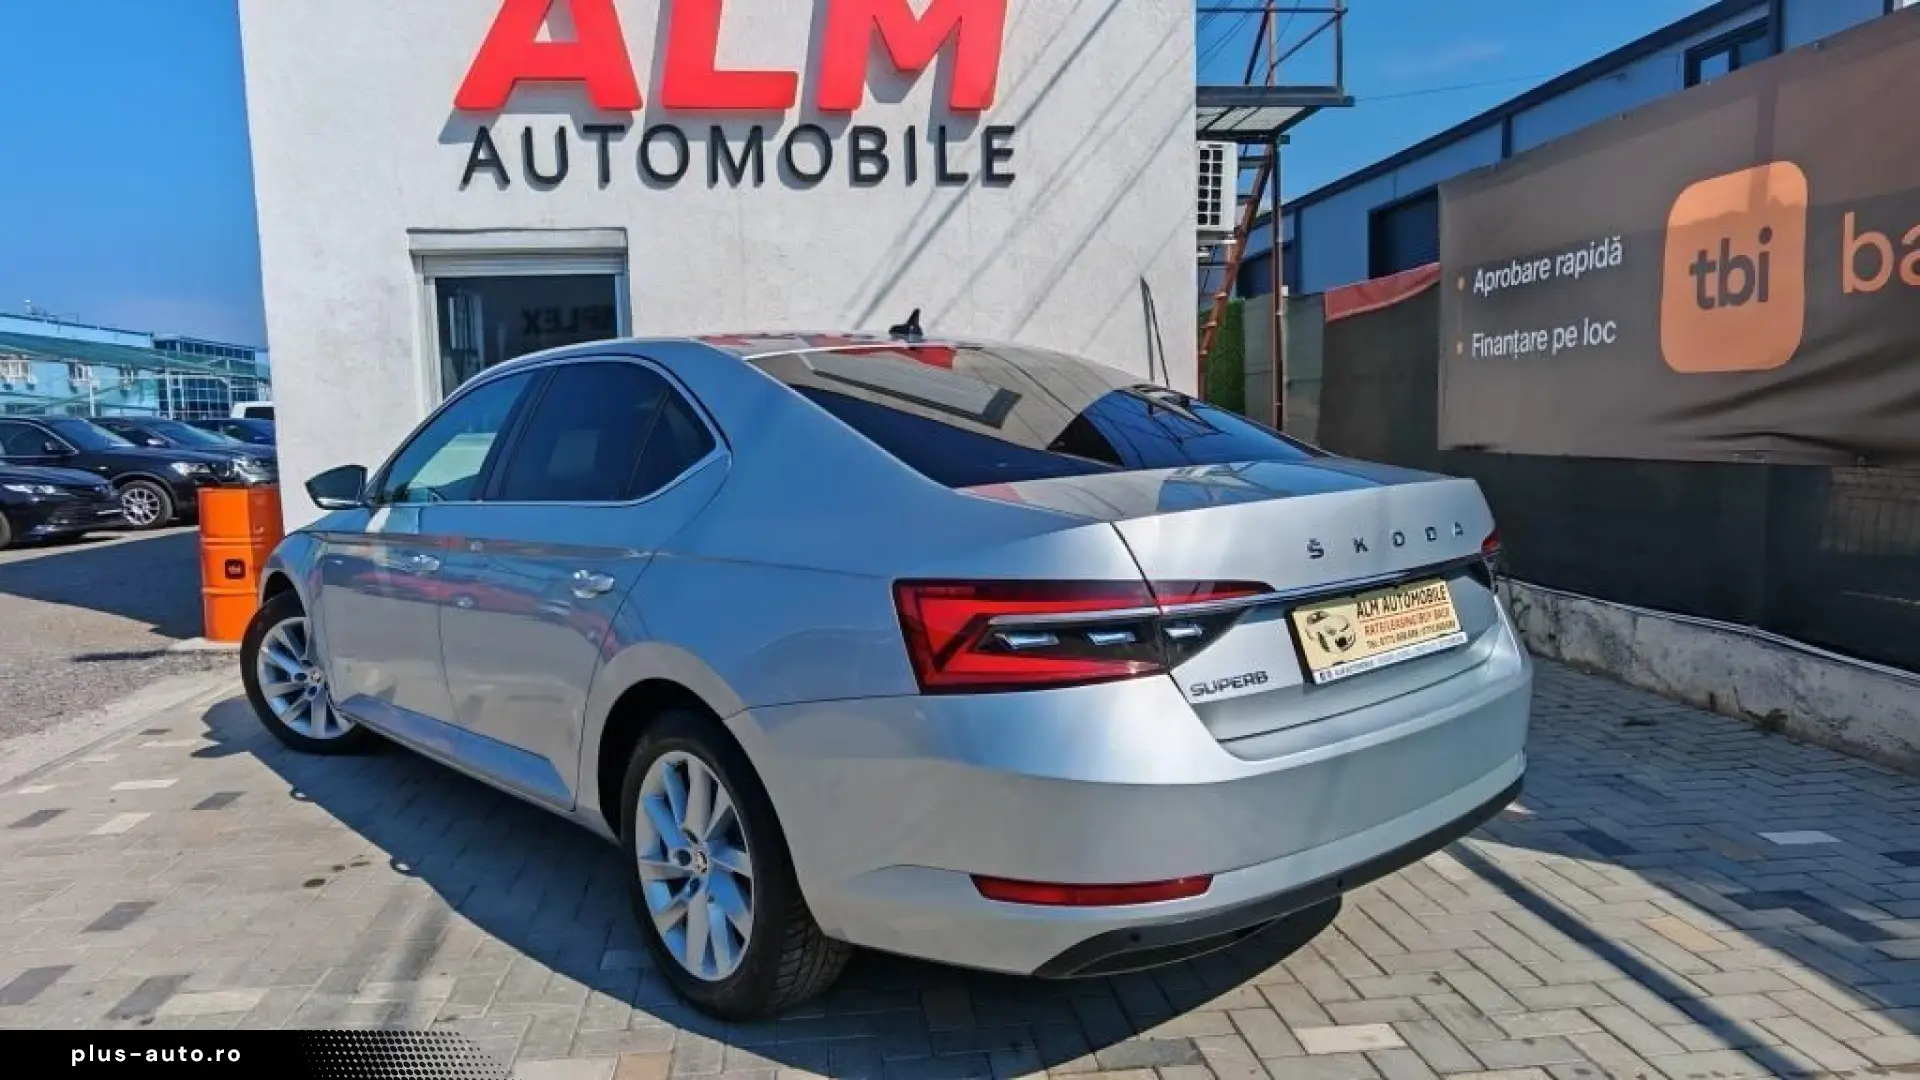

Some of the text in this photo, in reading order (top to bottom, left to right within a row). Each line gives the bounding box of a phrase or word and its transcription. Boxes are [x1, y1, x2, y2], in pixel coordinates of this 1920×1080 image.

[455, 0, 1007, 110] ALM
[459, 124, 1017, 188] AUTOMOBILE
[1473, 235, 1622, 297] Aprobare rapidă
[1689, 226, 1772, 310] tbi
[1471, 316, 1616, 359] Finanțare pe loc
[1357, 584, 1447, 619] ALM AUTOMOBILE
[1190, 670, 1268, 696] SUPERB
